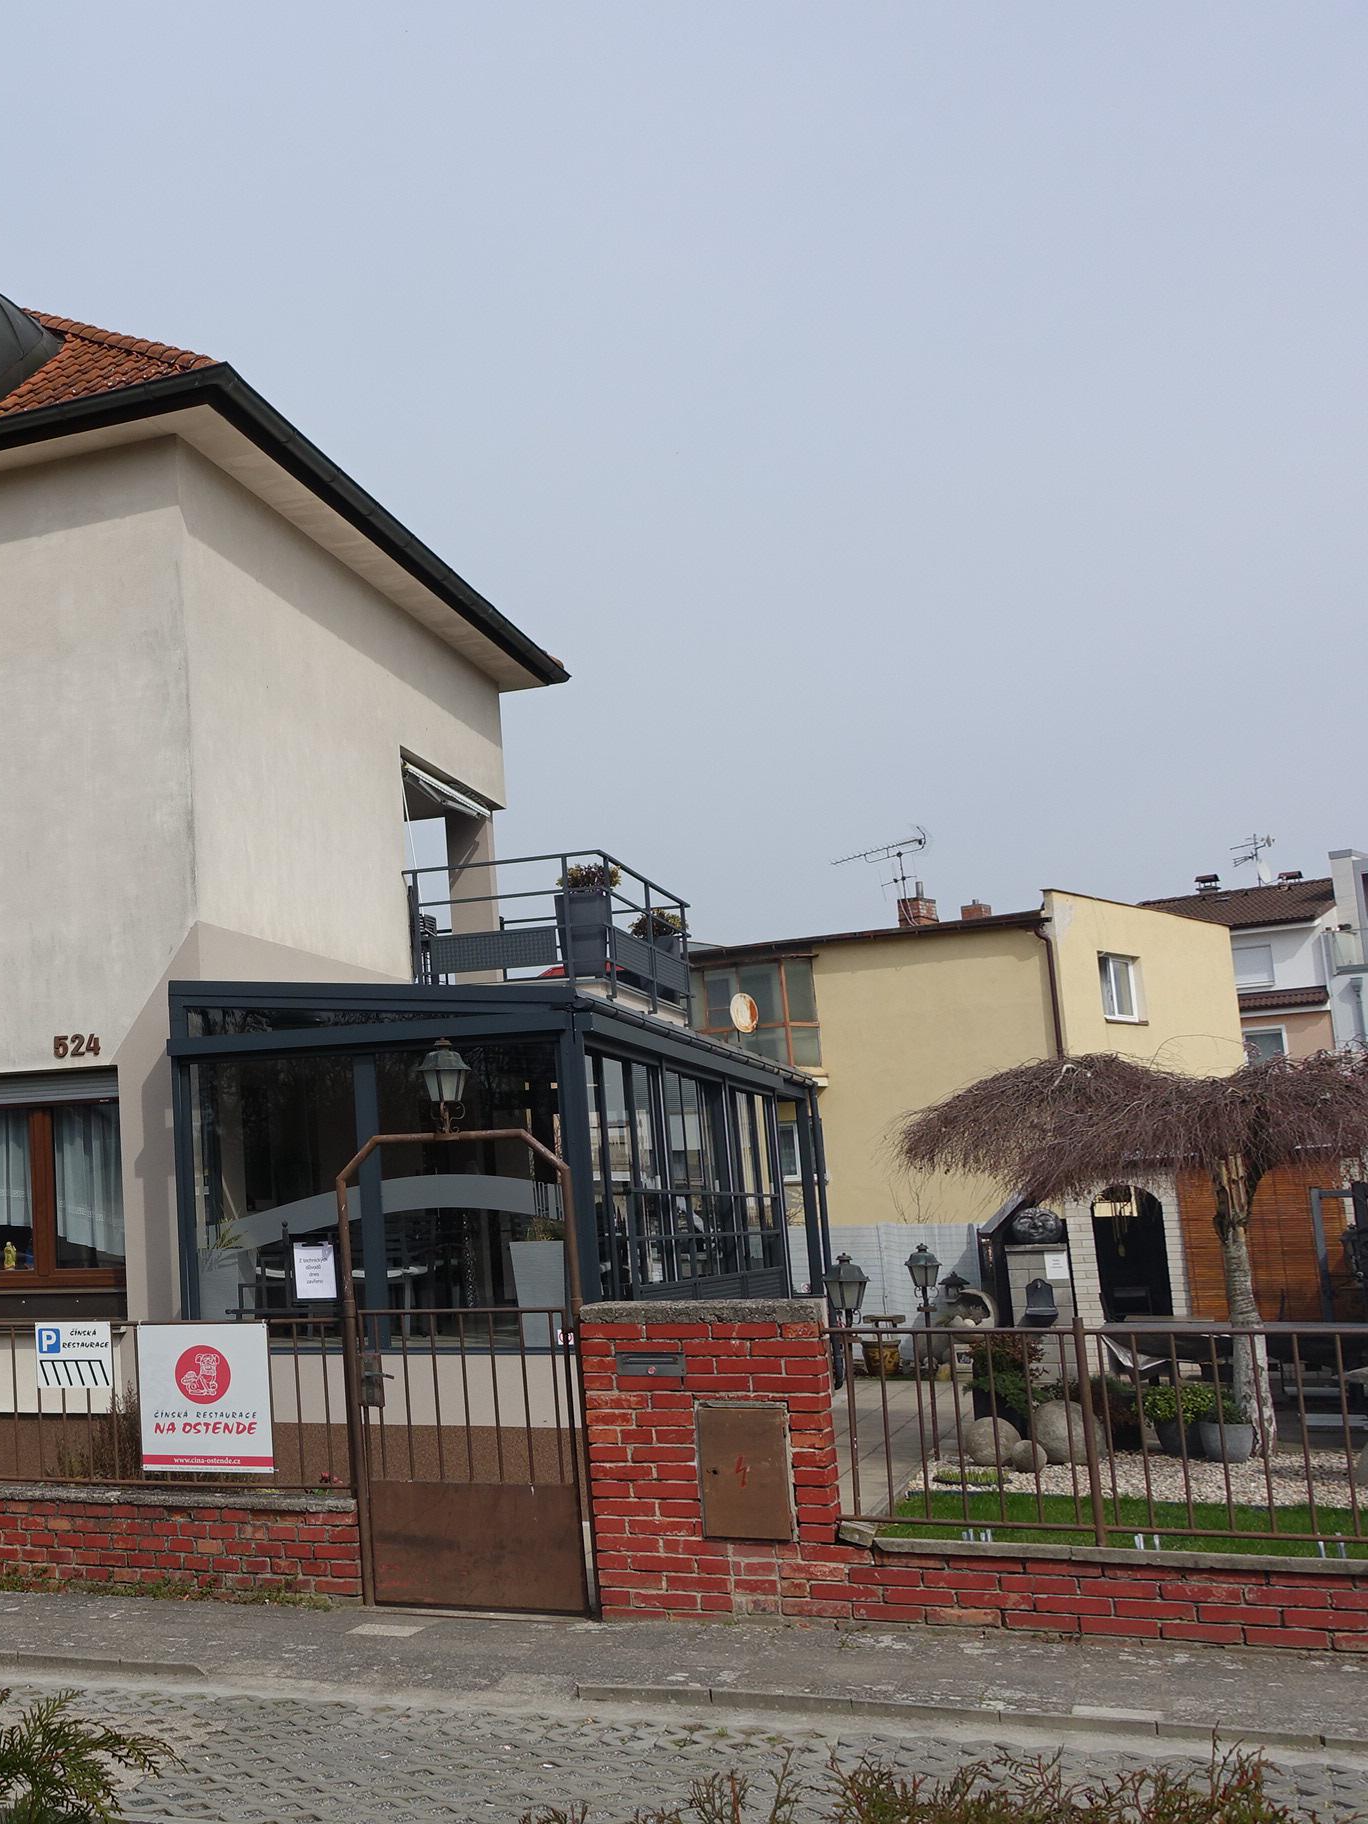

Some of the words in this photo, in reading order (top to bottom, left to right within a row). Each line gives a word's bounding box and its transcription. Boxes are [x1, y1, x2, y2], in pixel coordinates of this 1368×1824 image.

[53, 1033, 101, 1057] 524
[70, 1328, 97, 1336] ČÍNSKÁ
[42, 1330, 57, 1352] P
[154, 1410, 188, 1419] ČÍNSKÁ
[196, 1411, 257, 1419] RESTAURACE
[154, 1422, 176, 1435] NA
[182, 1421, 258, 1435] OSTENDE
